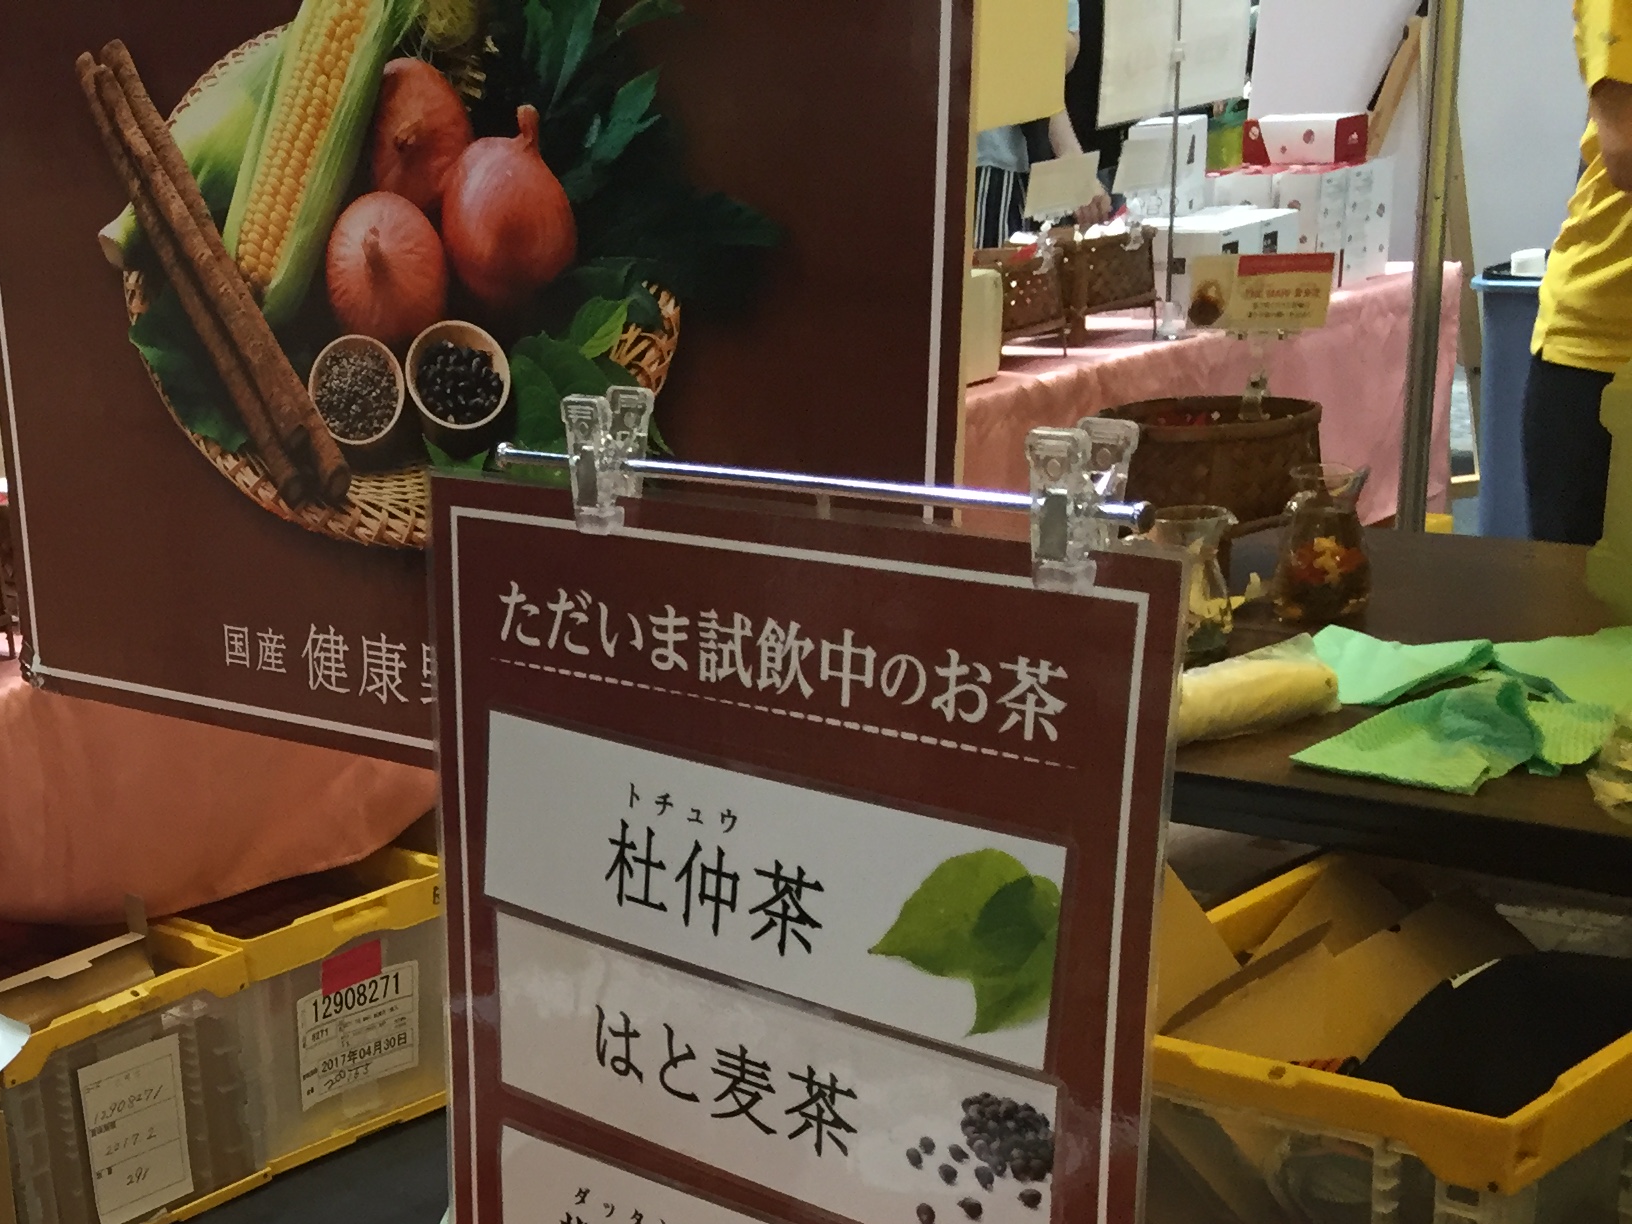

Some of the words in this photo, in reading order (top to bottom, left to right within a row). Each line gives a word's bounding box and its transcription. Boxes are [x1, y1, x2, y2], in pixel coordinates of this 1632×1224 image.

[498, 580, 1069, 743] ただいま試飲中のお茶
[627, 783, 739, 835] トチュウ
[605, 819, 825, 958] 杜仲茶
[312, 971, 400, 1024] 12908271
[321, 1031, 408, 1074] 2017年04月30日
[594, 1004, 858, 1157] はと麦茶
